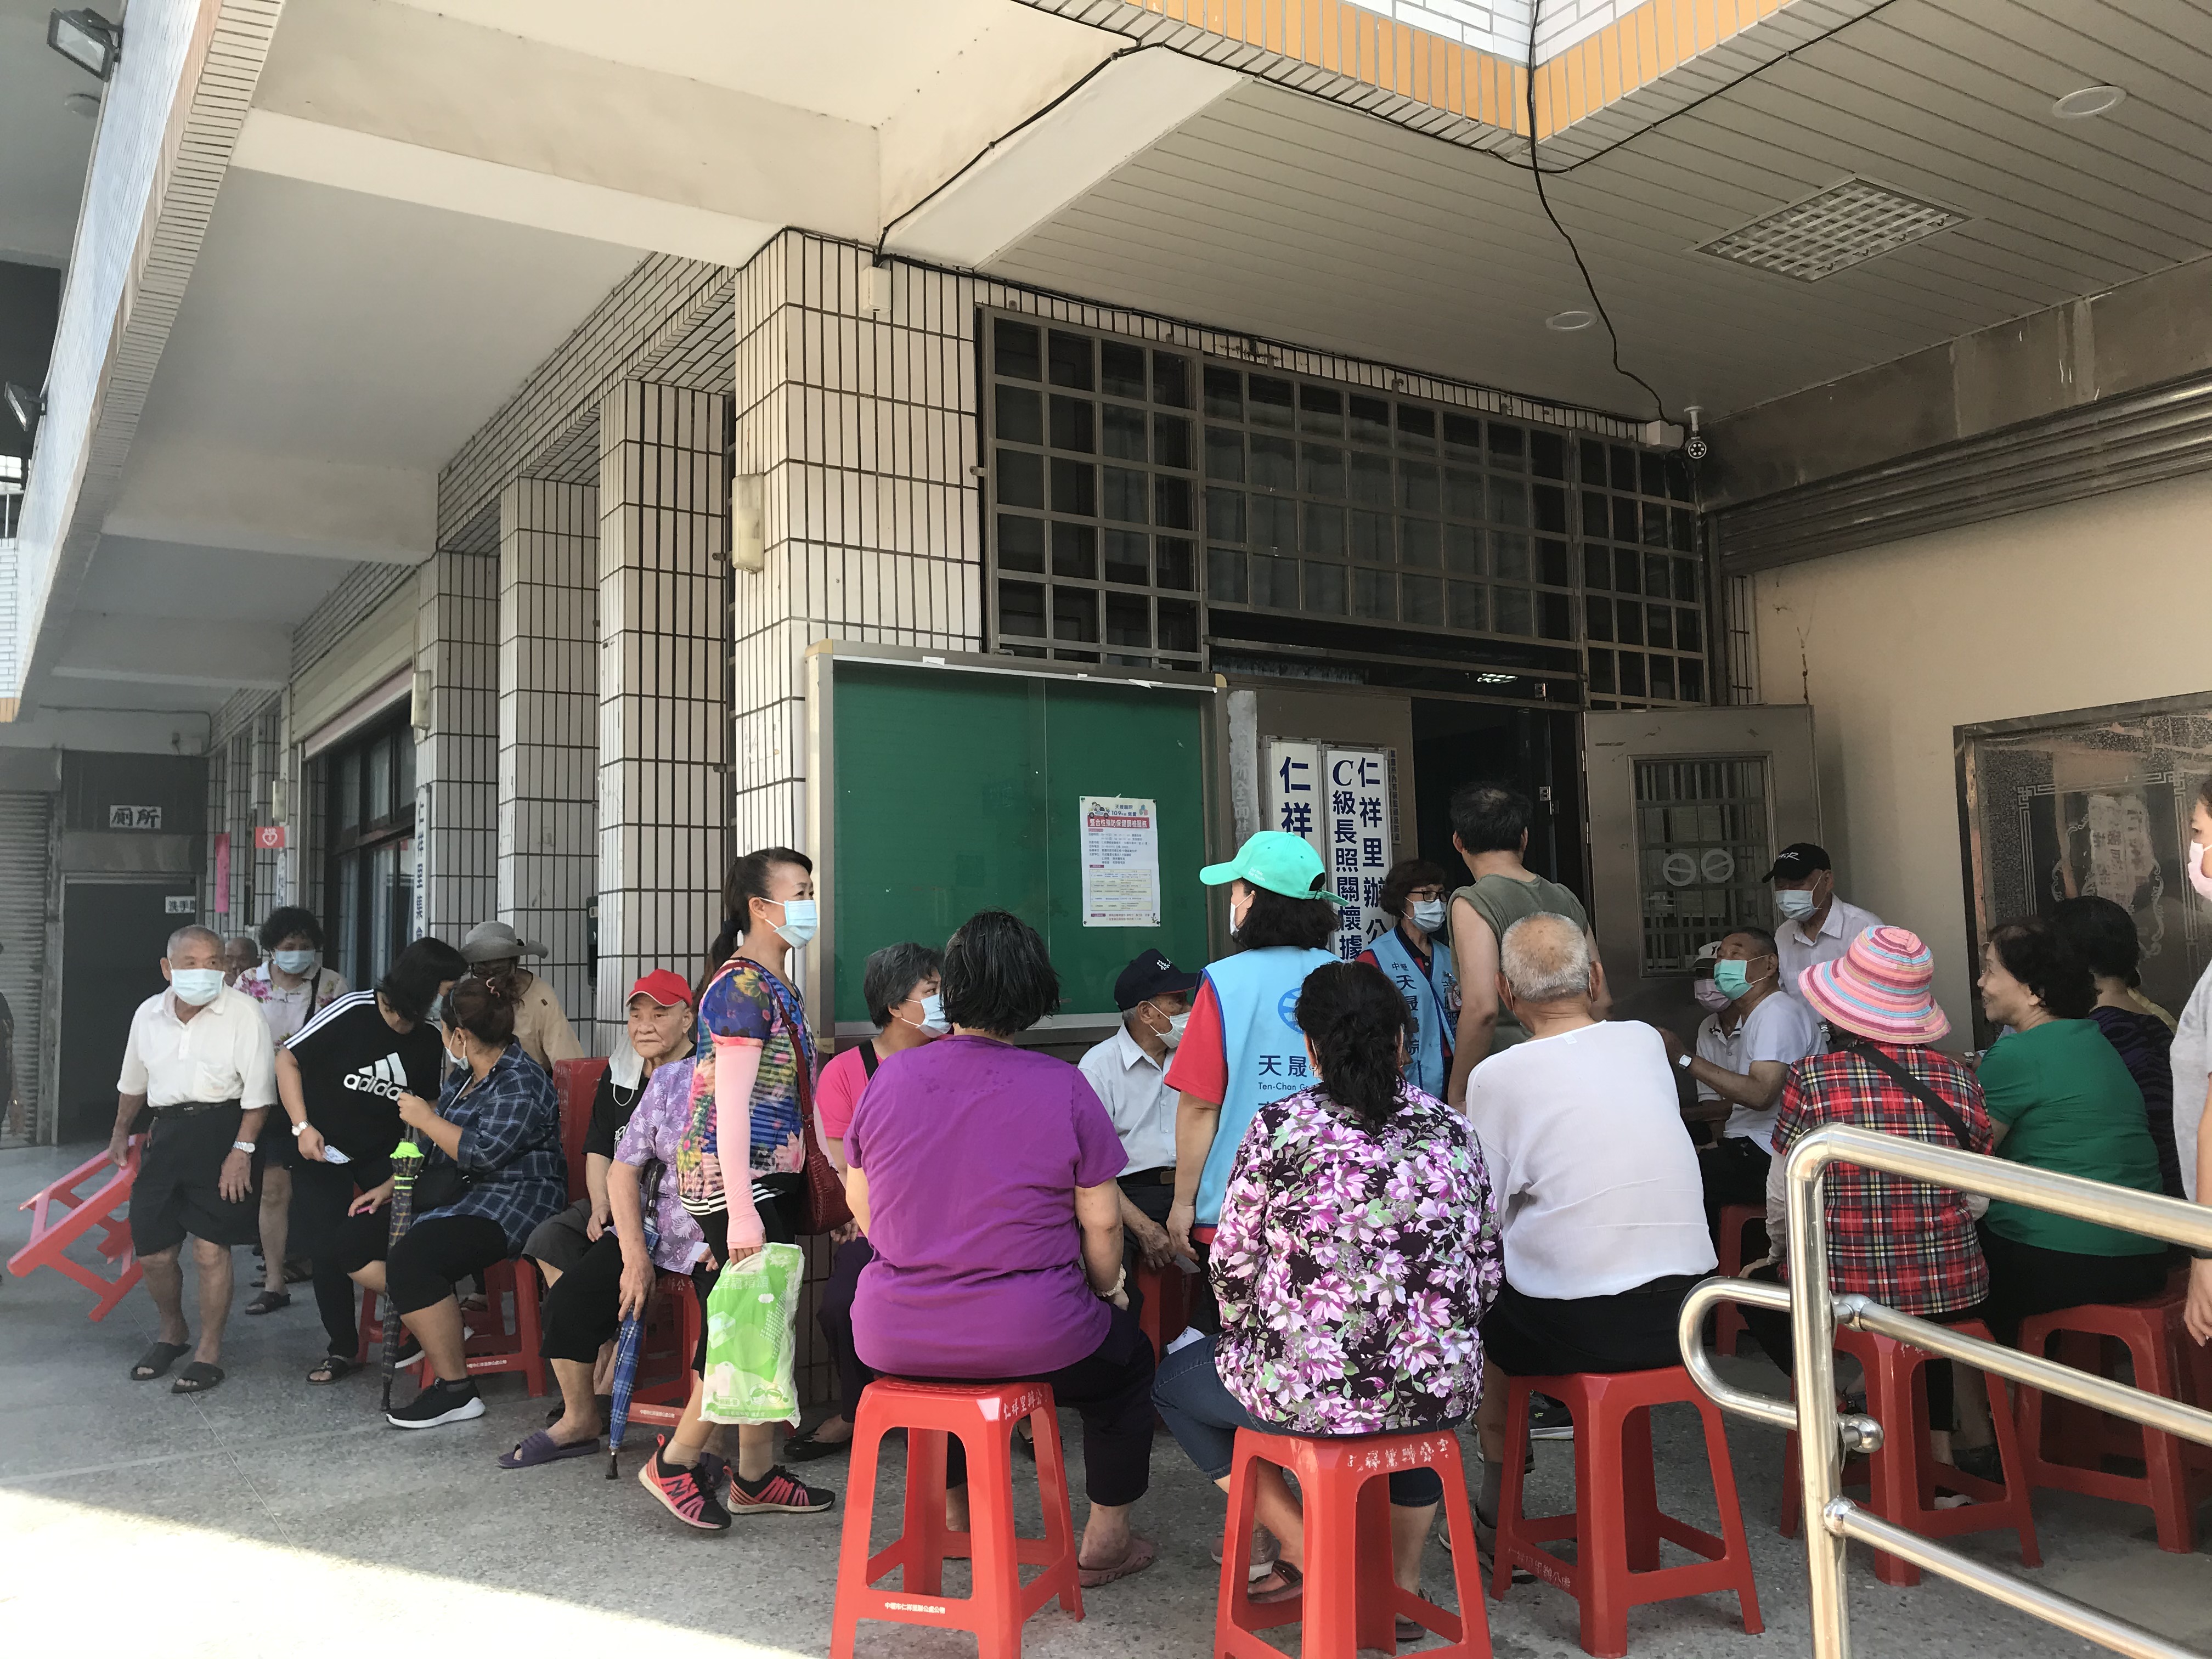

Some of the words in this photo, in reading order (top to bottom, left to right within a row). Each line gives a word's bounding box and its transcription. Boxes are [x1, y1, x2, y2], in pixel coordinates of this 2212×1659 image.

[1279, 756, 1313, 839] 仁祥
[1358, 757, 1389, 945] 仁祥里辦公
[1259, 1055, 1307, 1077] 天晟
[343, 1074, 404, 1102] adida
[1258, 1082, 1296, 1091] Ten-Chan
